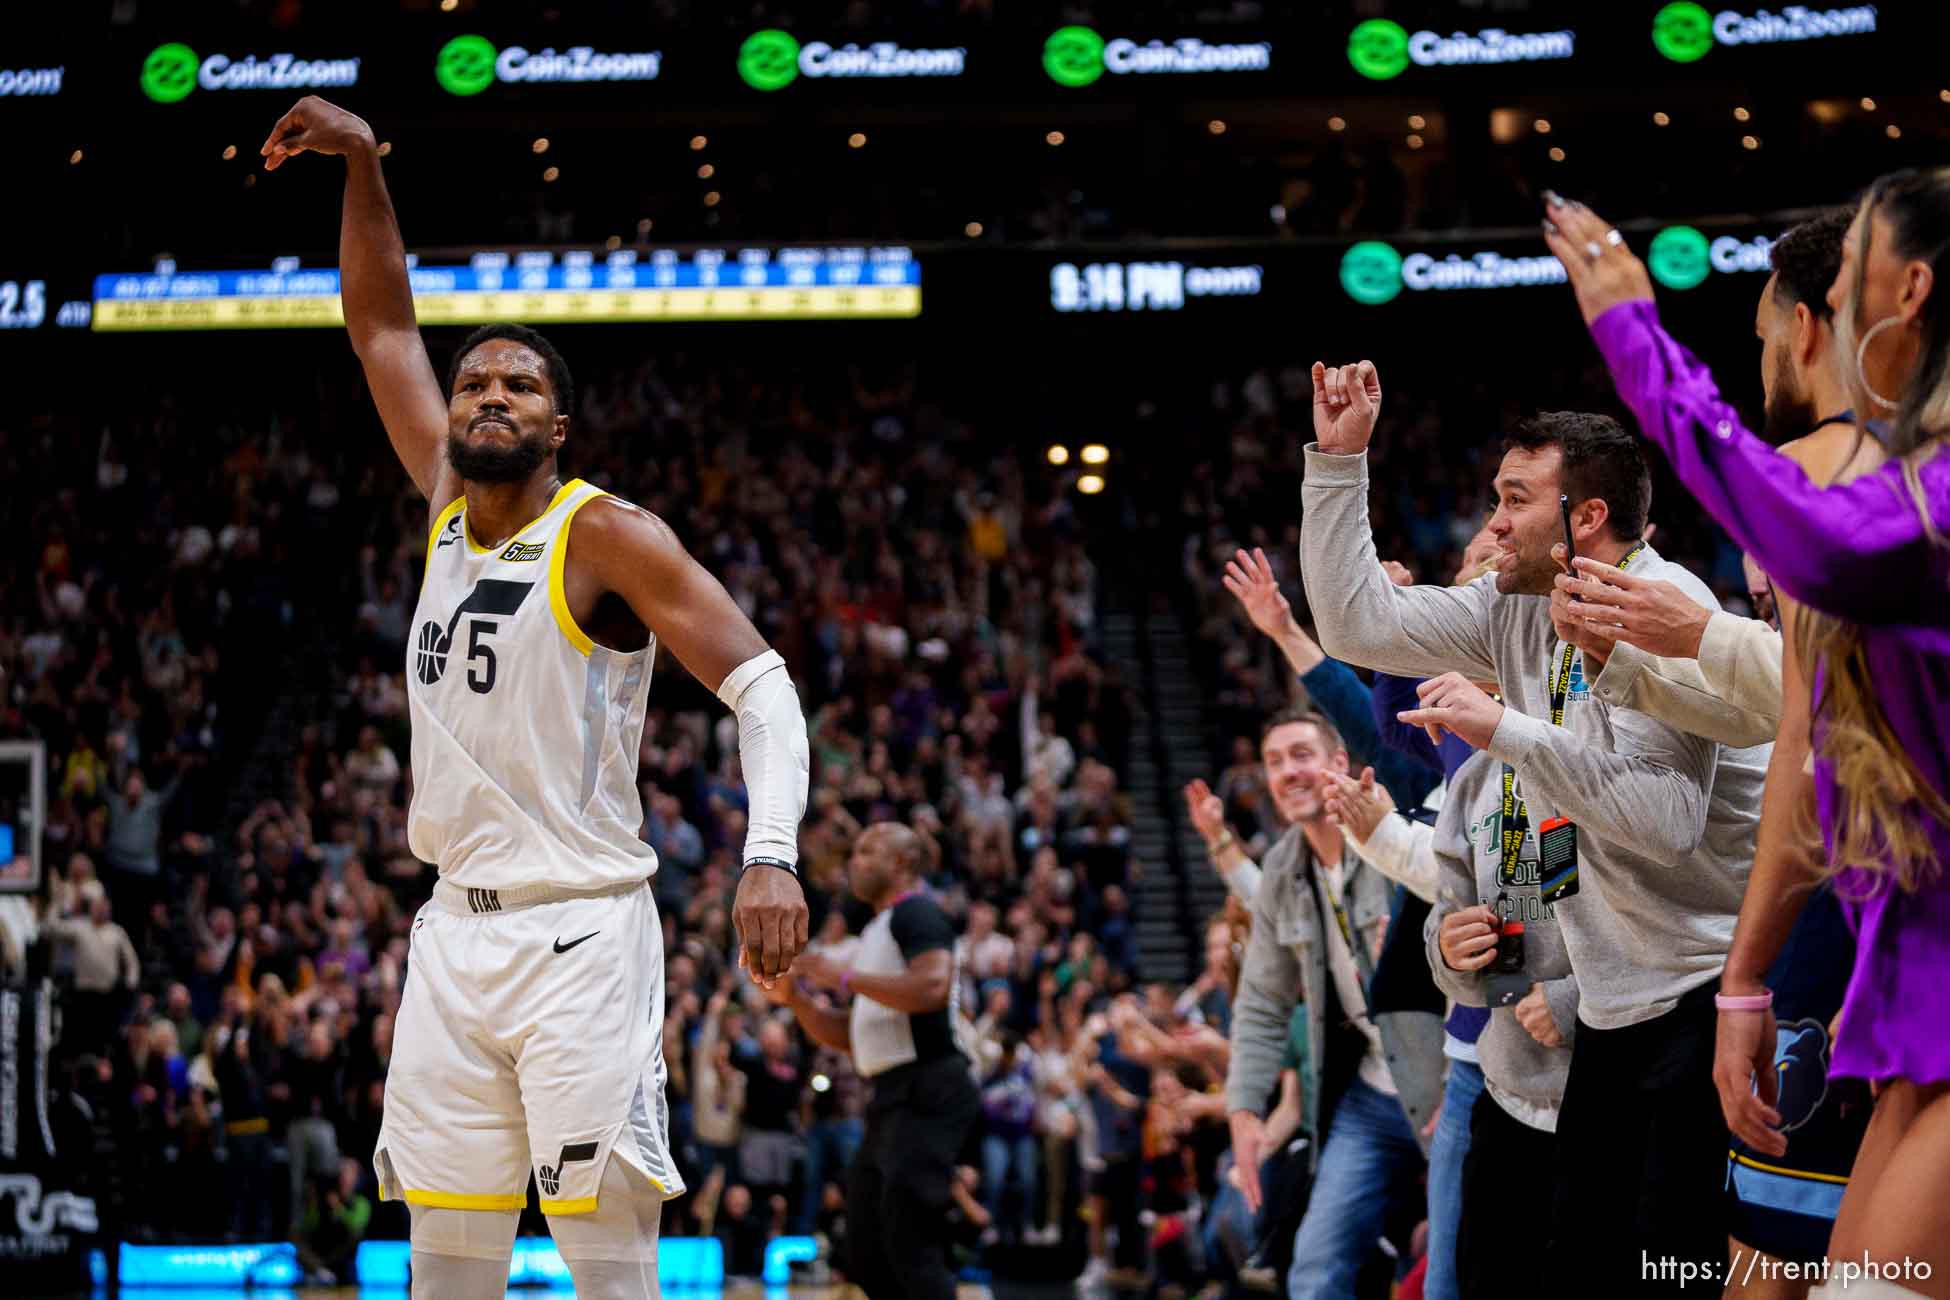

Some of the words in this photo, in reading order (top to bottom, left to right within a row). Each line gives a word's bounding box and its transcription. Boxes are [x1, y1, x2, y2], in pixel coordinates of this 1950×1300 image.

[1713, 6, 1875, 45] CoinZoom
[497, 46, 660, 83] CoinZoom
[798, 41, 966, 79] CoinZoom
[1104, 38, 1269, 74] CoinZoom
[1408, 28, 1573, 66] CoinZoom
[199, 53, 358, 90] CoinZoom
[1127, 262, 1184, 310] PM
[1403, 250, 1566, 291] CoinZoom
[503, 543, 523, 560] 5
[468, 619, 499, 695] 5
[1503, 772, 1513, 791] UTAH
[467, 887, 502, 915] UTAH
